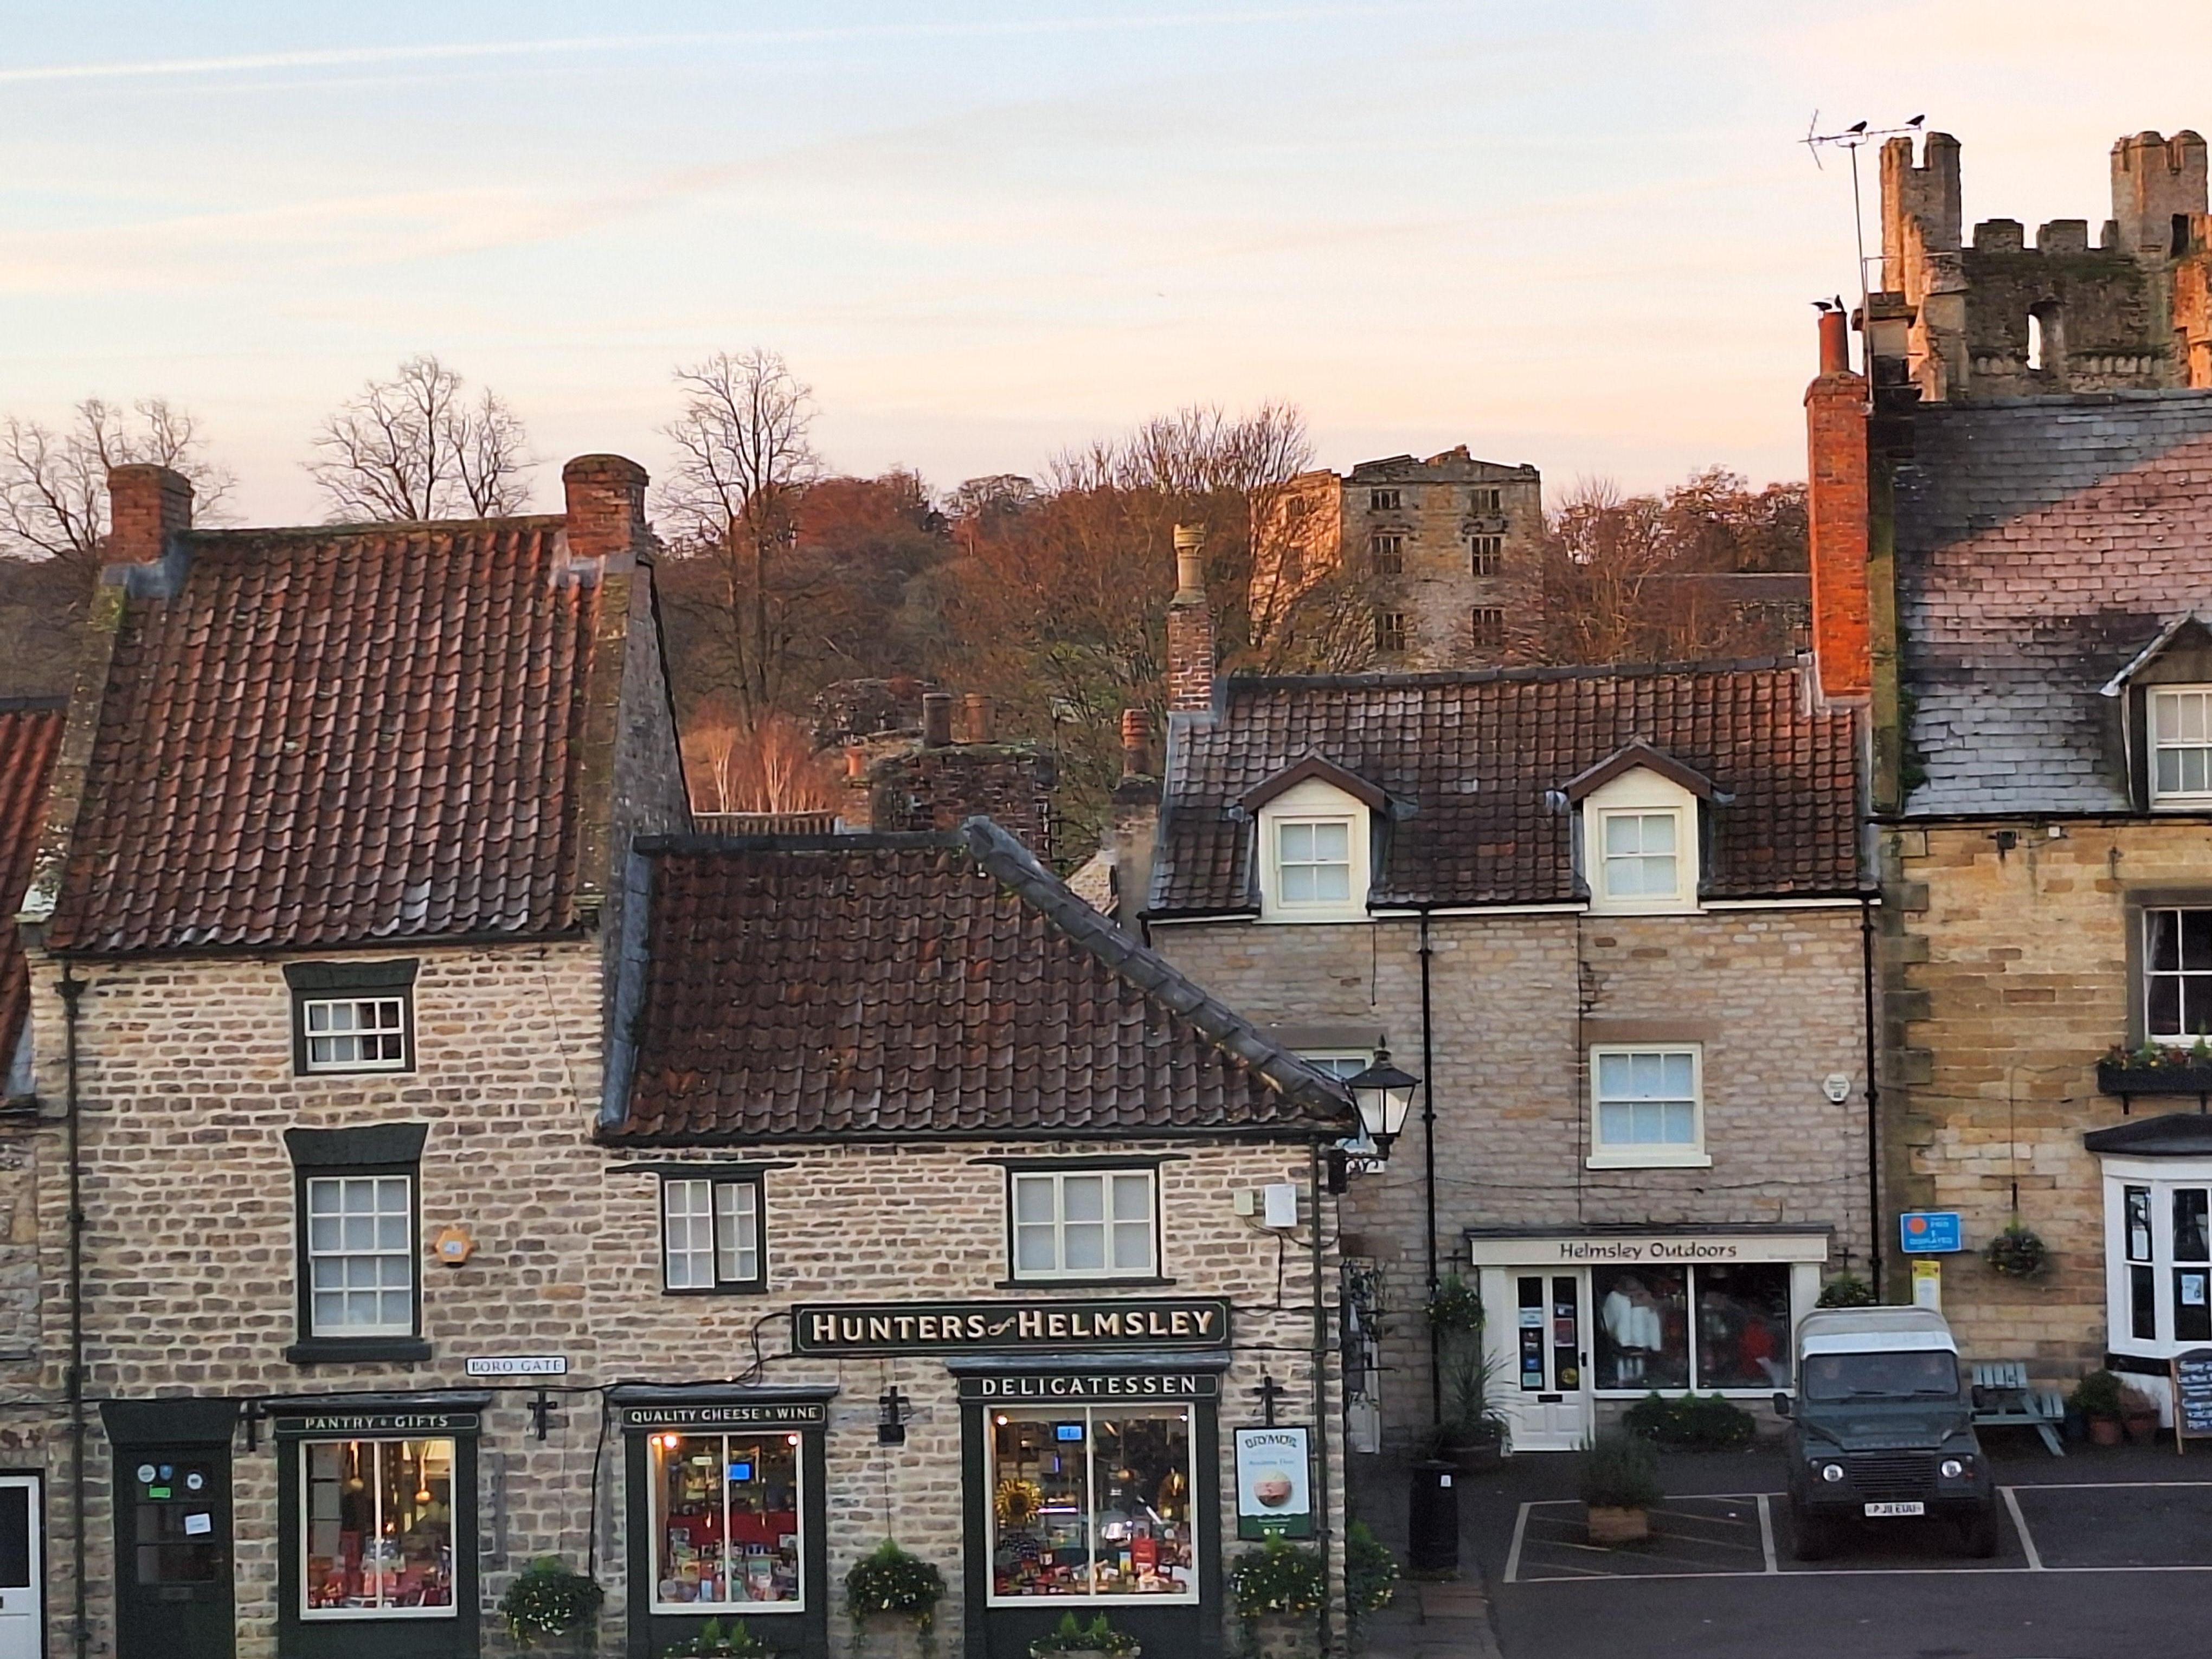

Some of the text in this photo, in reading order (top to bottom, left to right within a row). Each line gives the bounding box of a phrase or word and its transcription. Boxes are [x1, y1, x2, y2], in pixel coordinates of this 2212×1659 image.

[1560, 1242, 1737, 1260] Helmsley Outdoors
[813, 1314, 985, 1342] HUNTERS
[1018, 1310, 1214, 1338] HELMSLEY
[472, 1360, 561, 1372] BORO GATE
[981, 1375, 1197, 1395] DELICATESSEN
[305, 1416, 374, 1429] PANTRY
[395, 1415, 449, 1427] GIFTS
[631, 1410, 696, 1424] QUALITY
[701, 1408, 759, 1421] CHEESE
[776, 1406, 817, 1419] WINE
